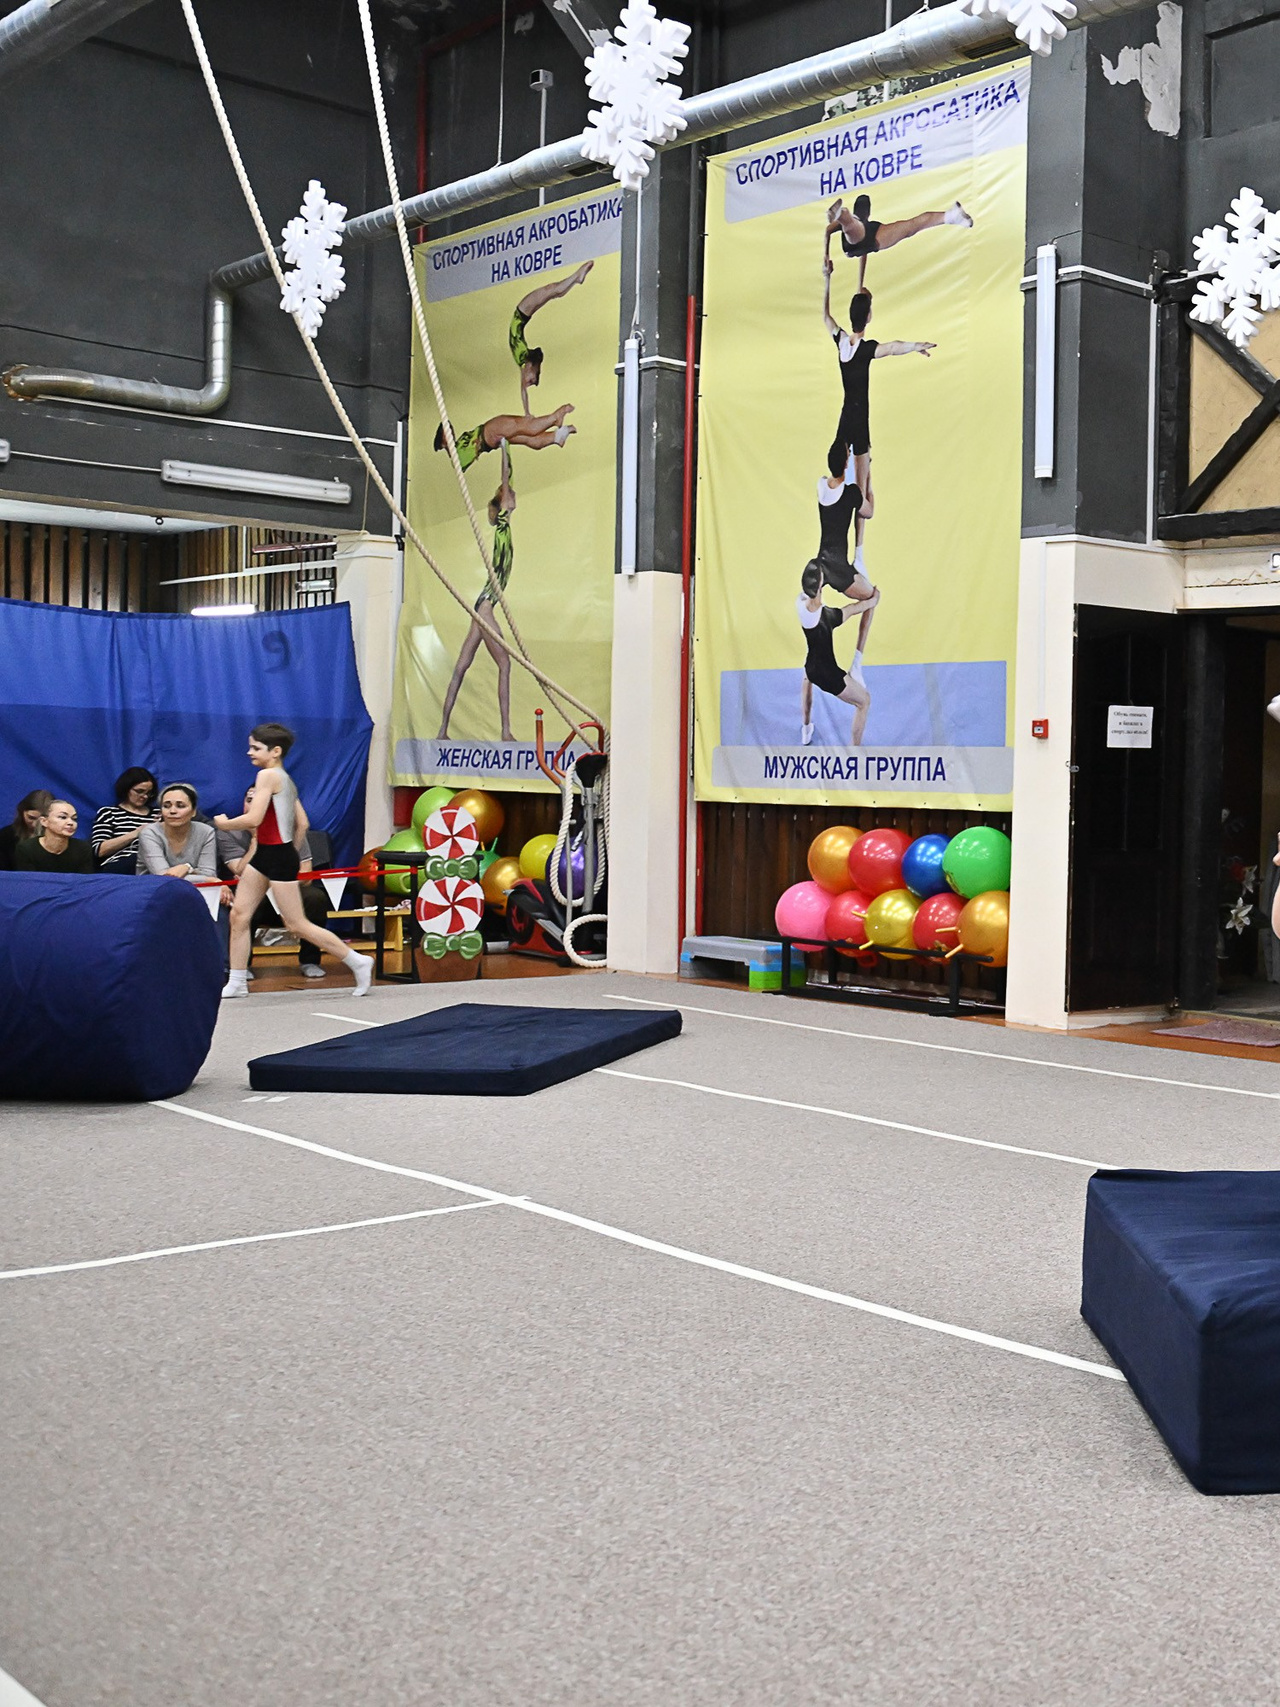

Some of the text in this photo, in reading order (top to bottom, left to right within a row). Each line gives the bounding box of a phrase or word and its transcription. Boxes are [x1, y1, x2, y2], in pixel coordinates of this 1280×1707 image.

[736, 79, 1021, 186] СПОРТИВНАЯ АКРОБАТИКА
[819, 144, 924, 196] НА КОВРЕ
[432, 225, 526, 271] СПОРТИВНАЯ
[491, 244, 563, 284] НА КОВРЕ
[436, 747, 512, 770] ЖЕНСКАЯ
[763, 755, 947, 782] МУЖСКАЯ ГРУППА
